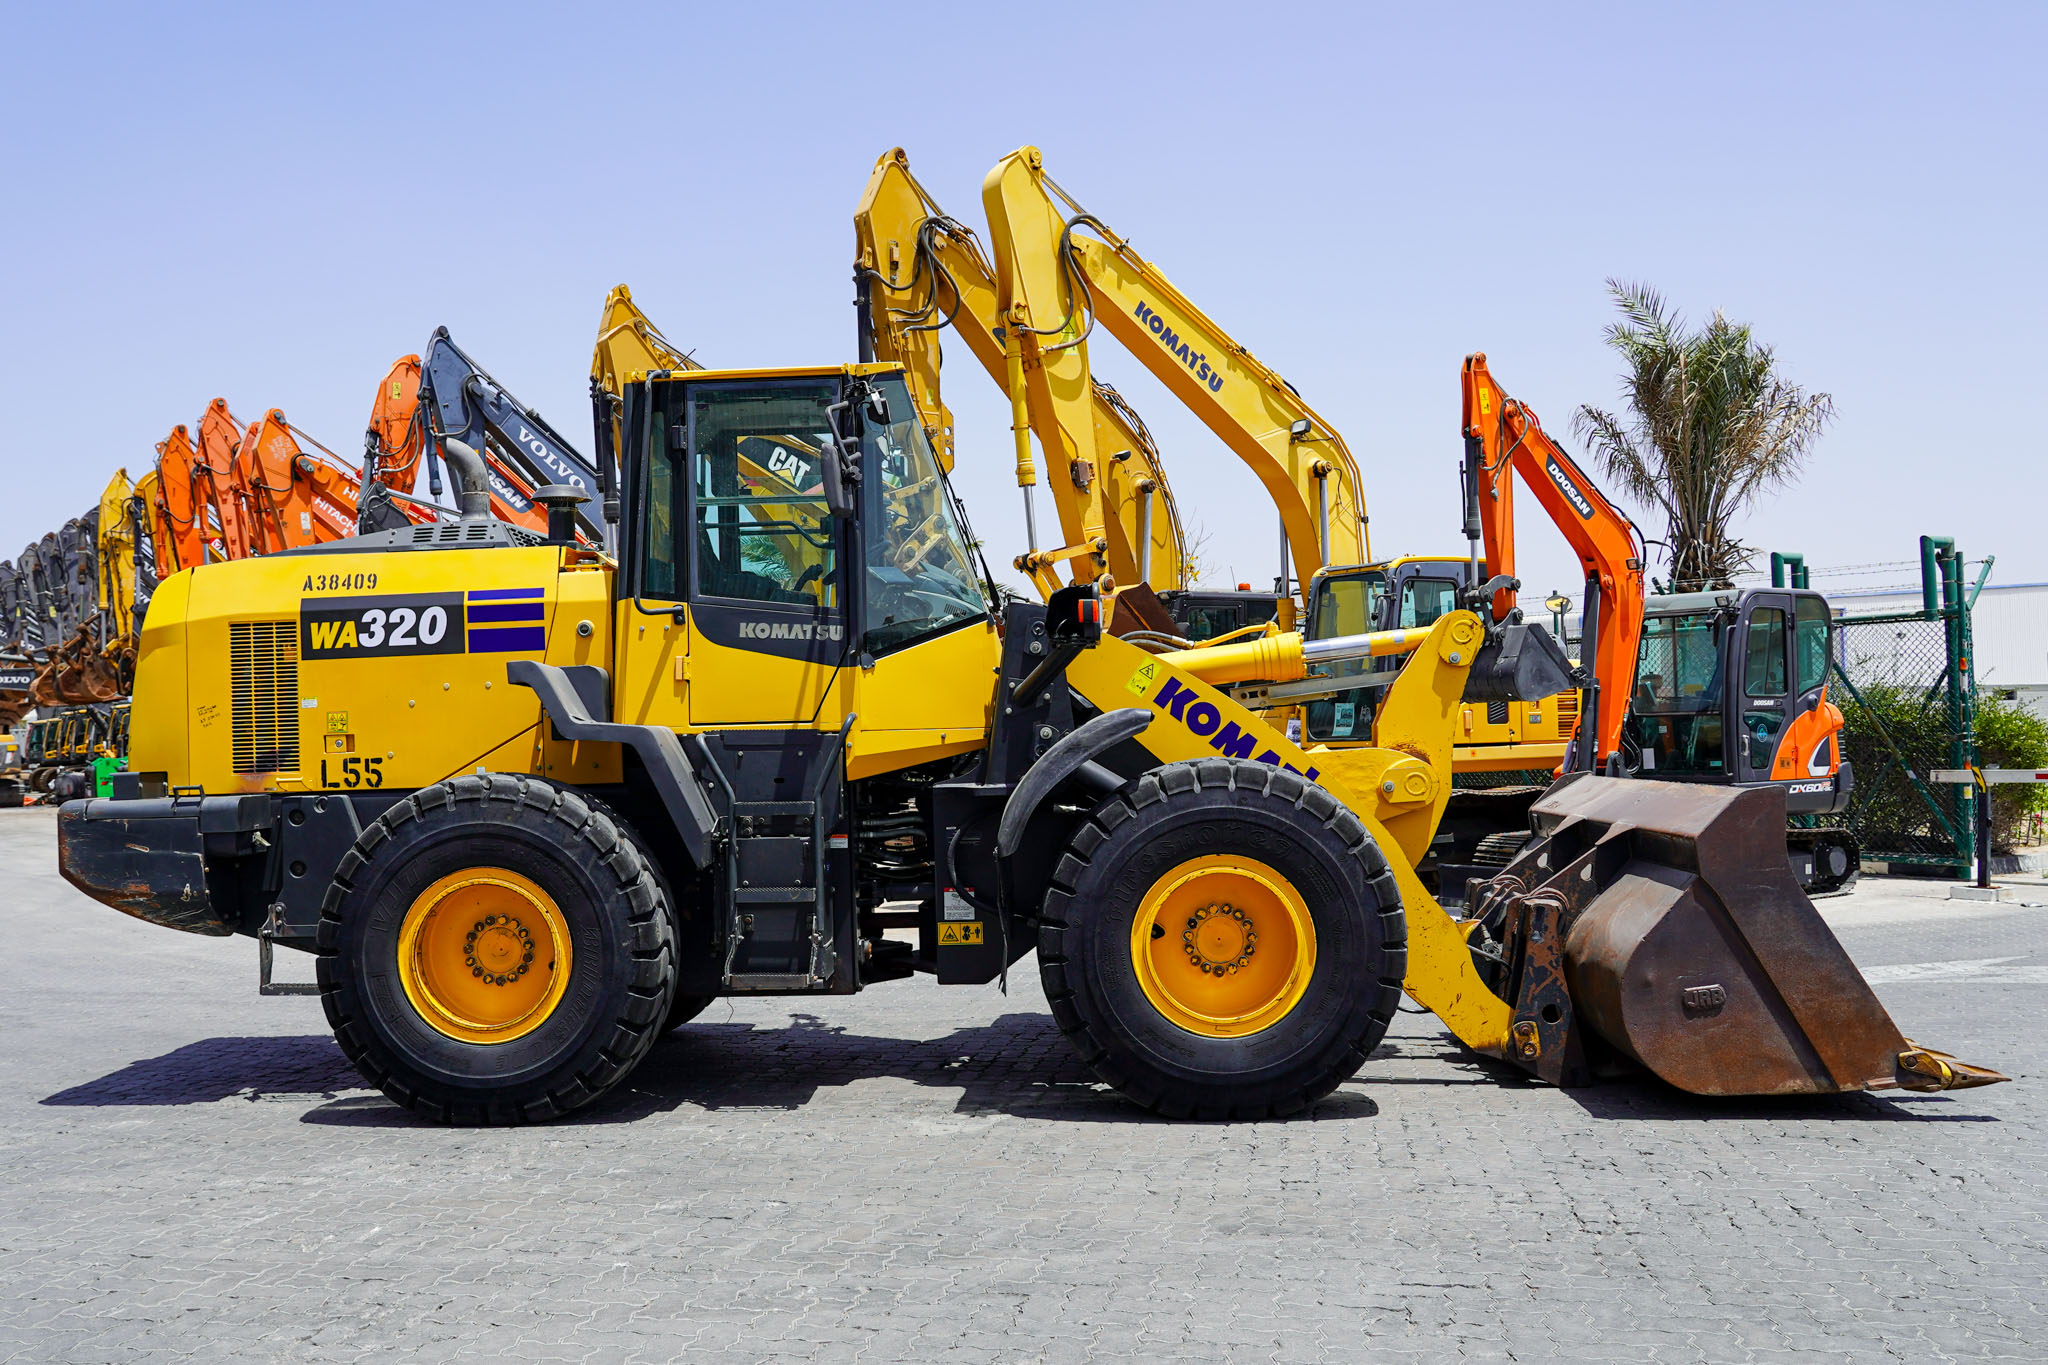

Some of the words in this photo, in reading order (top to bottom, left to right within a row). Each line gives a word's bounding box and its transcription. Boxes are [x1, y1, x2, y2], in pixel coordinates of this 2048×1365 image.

[1134, 300, 1224, 393] KOMATSU
[519, 426, 586, 488] VOLVO
[768, 446, 811, 487] CAT
[488, 469, 527, 509] OSAN
[1548, 463, 1591, 515] DOOSAN
[314, 496, 358, 534] HITACH
[303, 573, 378, 592] A38409
[310, 606, 448, 650] WA320
[739, 620, 844, 641] KOMATSU
[321, 757, 383, 789] L55
